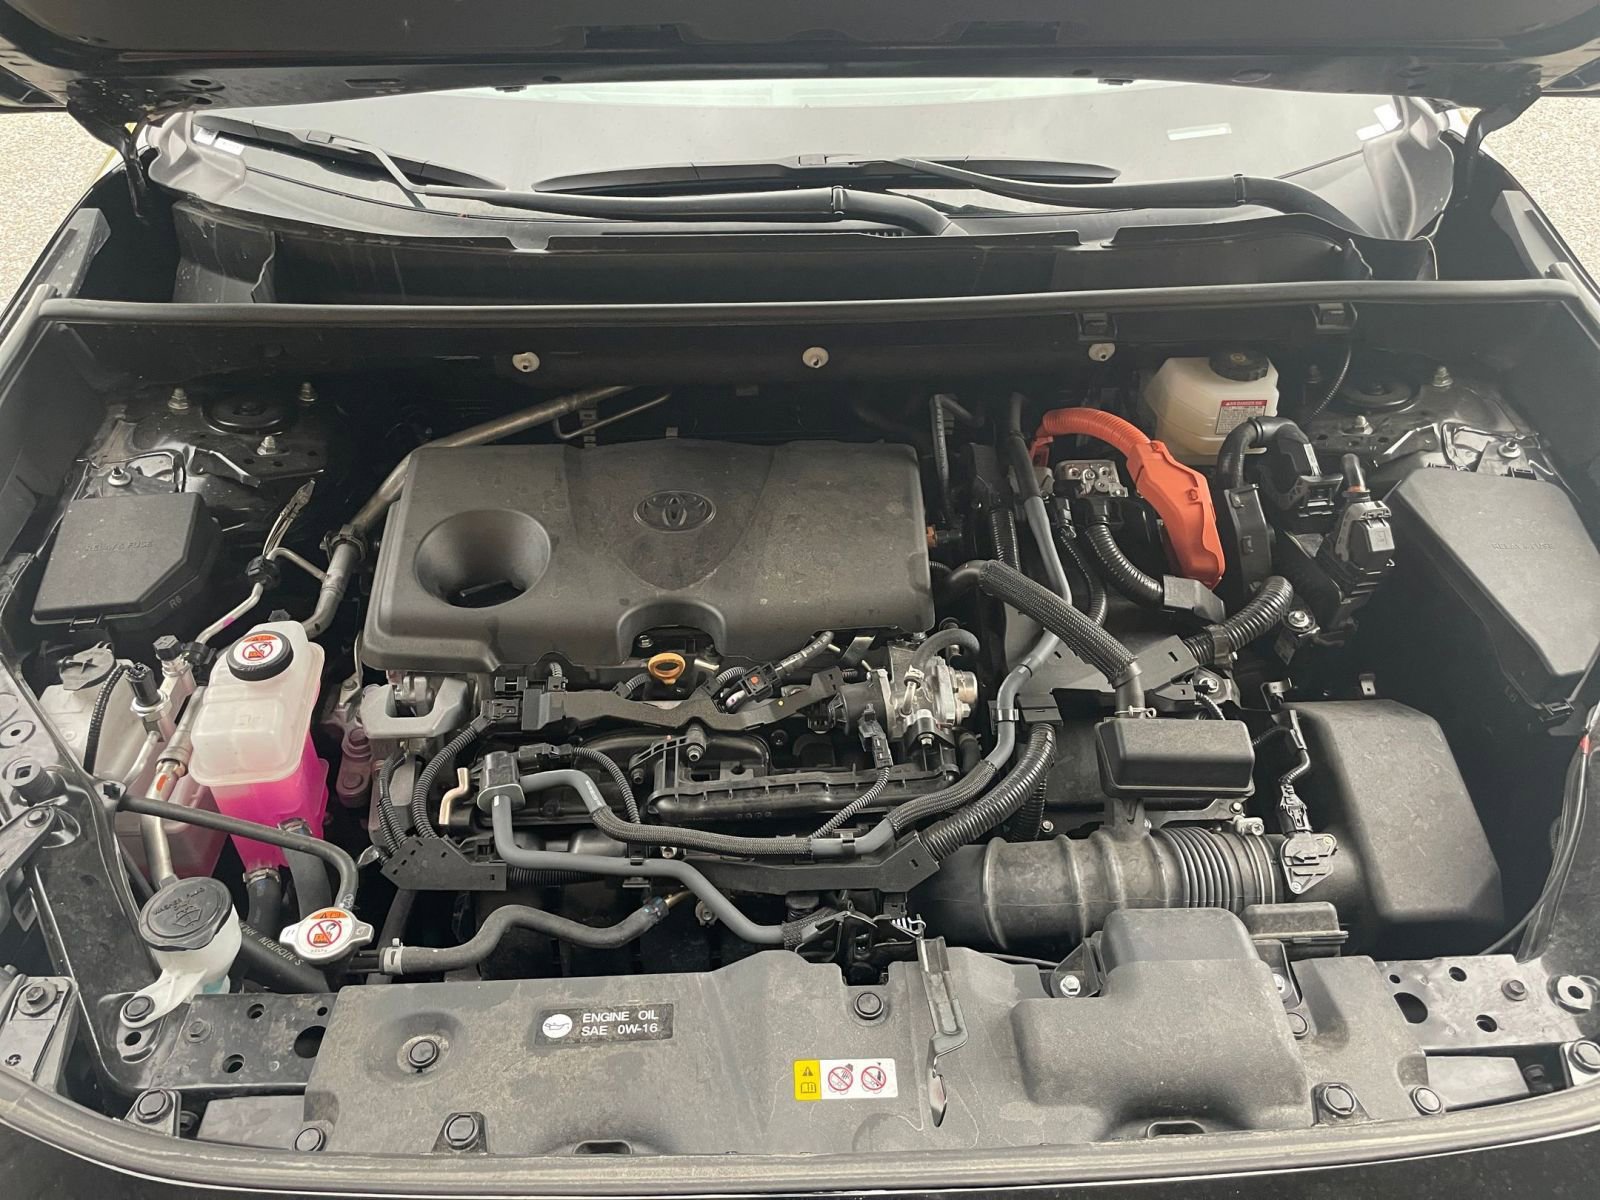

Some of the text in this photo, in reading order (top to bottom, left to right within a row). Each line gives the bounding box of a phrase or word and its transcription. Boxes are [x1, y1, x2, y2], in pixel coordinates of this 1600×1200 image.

[583, 1009, 659, 1023] ENGINE OIL
[581, 1023, 658, 1036] SAE 0W-16
